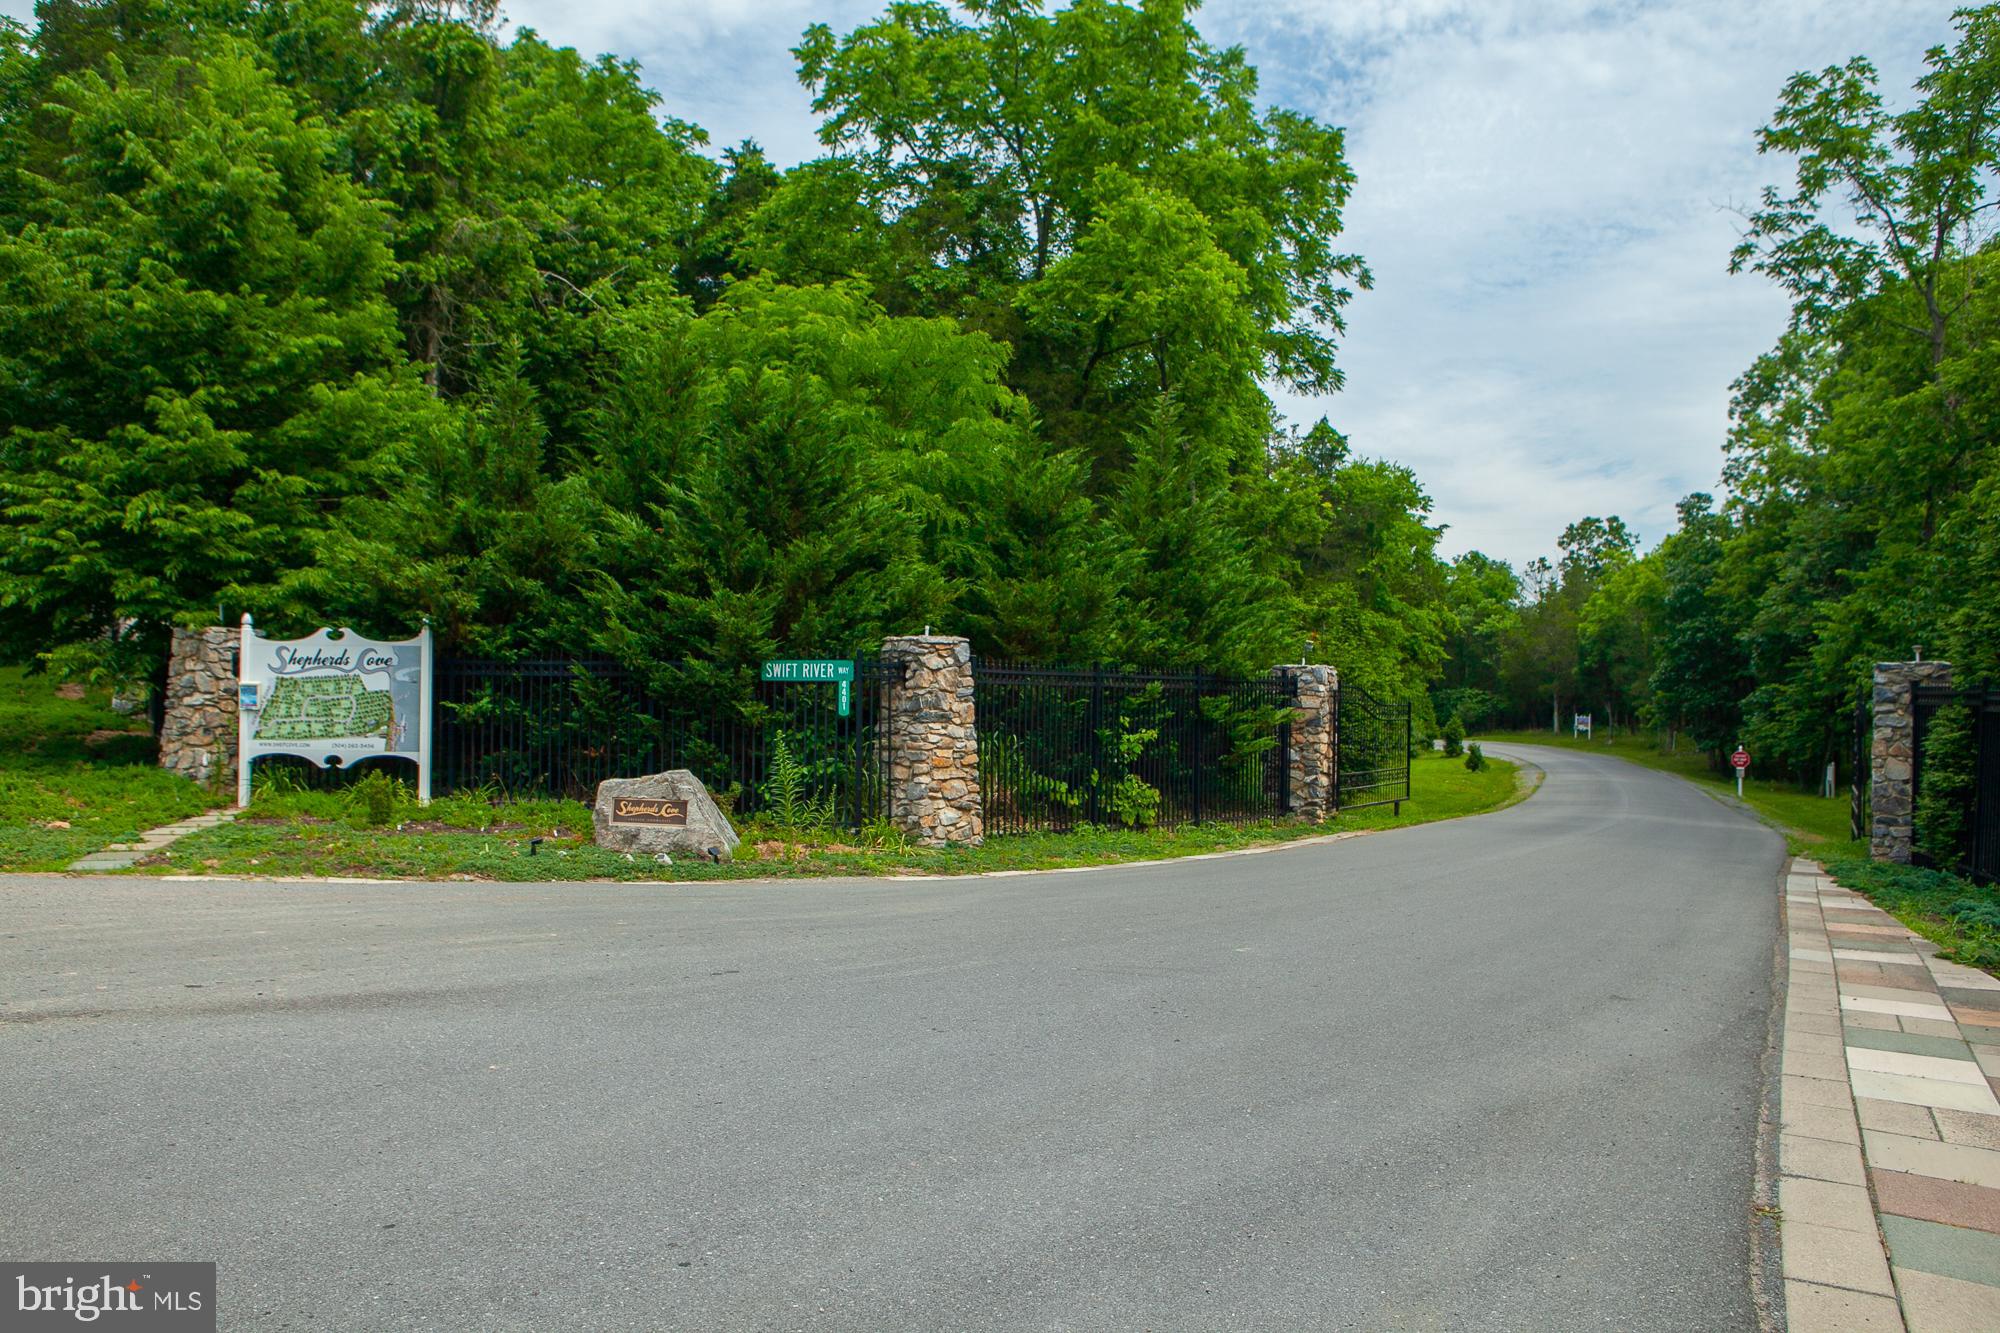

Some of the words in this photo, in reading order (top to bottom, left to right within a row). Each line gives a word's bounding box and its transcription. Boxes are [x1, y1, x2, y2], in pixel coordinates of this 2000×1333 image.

[267, 645, 350, 673] Shepherds
[354, 647, 394, 674] Cove
[765, 662, 798, 678] SWIFT
[802, 663, 834, 678] RIVER
[837, 666, 849, 674] WAY
[615, 800, 659, 816] Shepherds
[659, 803, 681, 817] Cove
